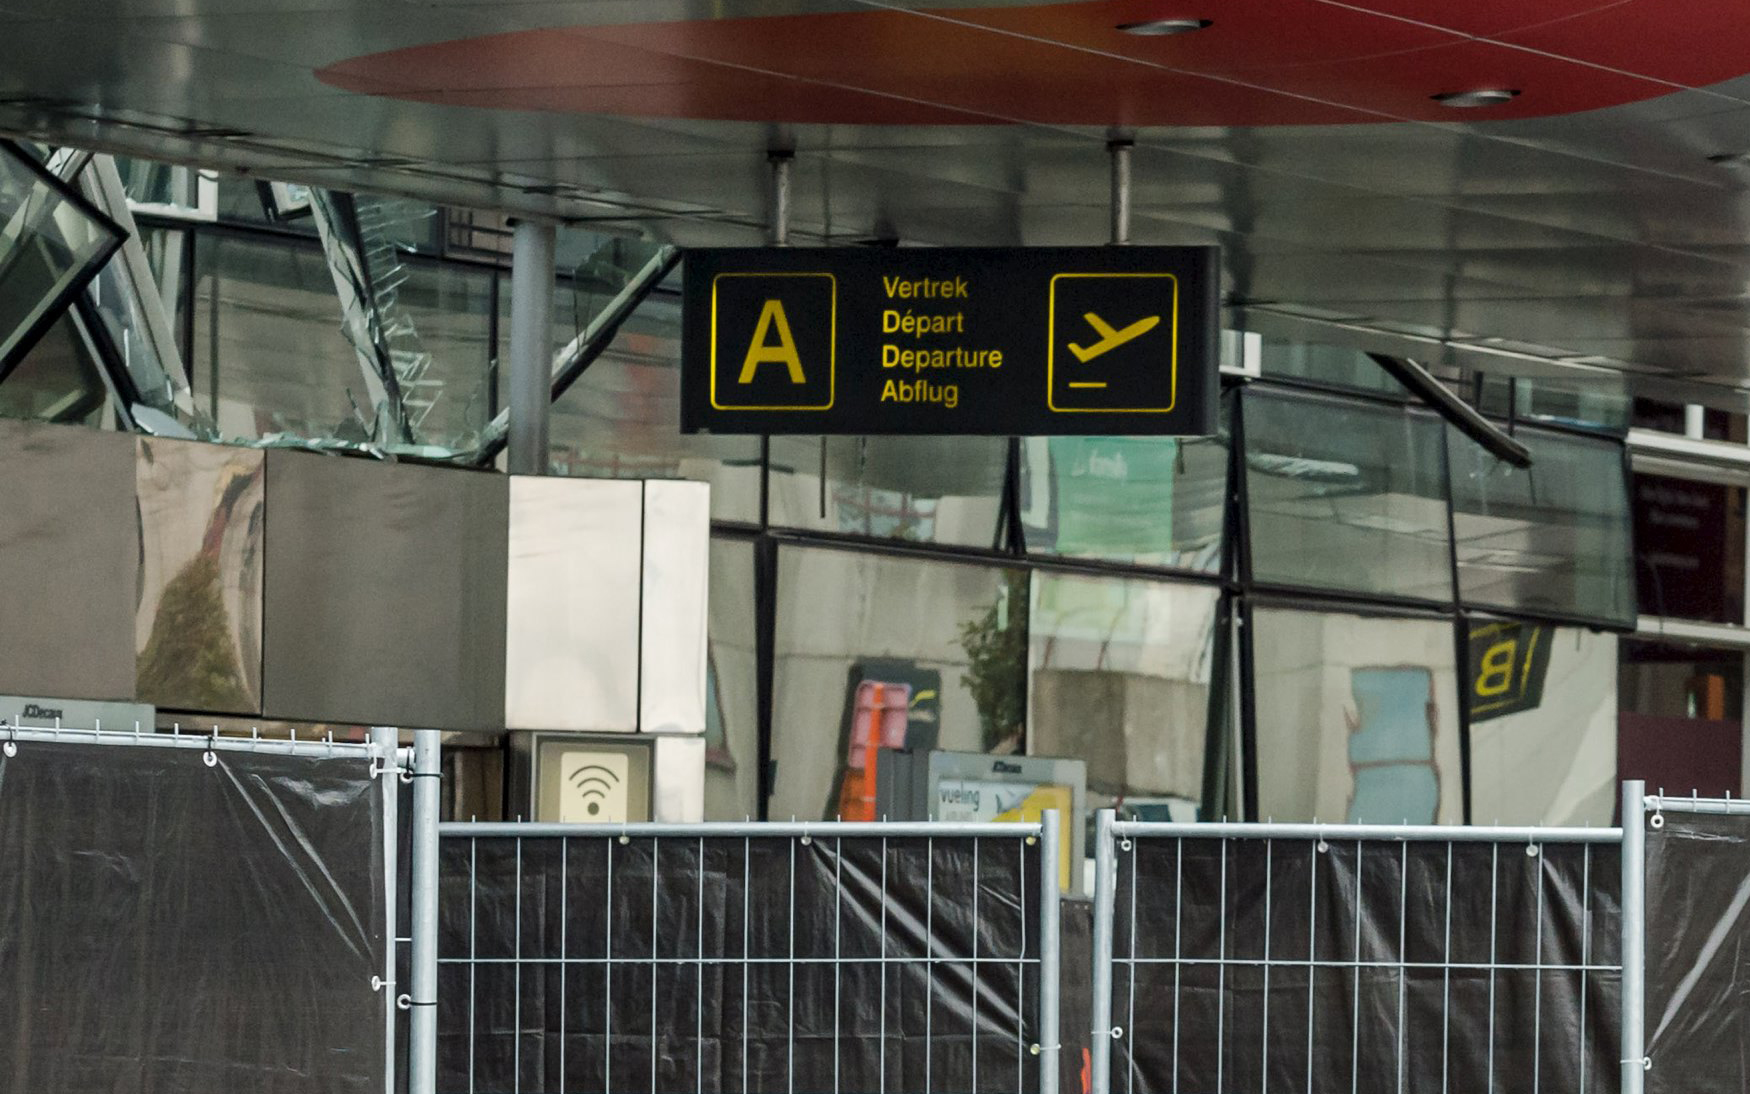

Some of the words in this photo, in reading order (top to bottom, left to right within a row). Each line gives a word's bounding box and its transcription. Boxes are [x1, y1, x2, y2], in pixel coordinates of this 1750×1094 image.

[883, 275, 969, 298] Vertrek
[882, 309, 964, 338] Départ
[737, 299, 807, 384] A
[882, 344, 1003, 373] Departure
[881, 379, 959, 408] Abflug
